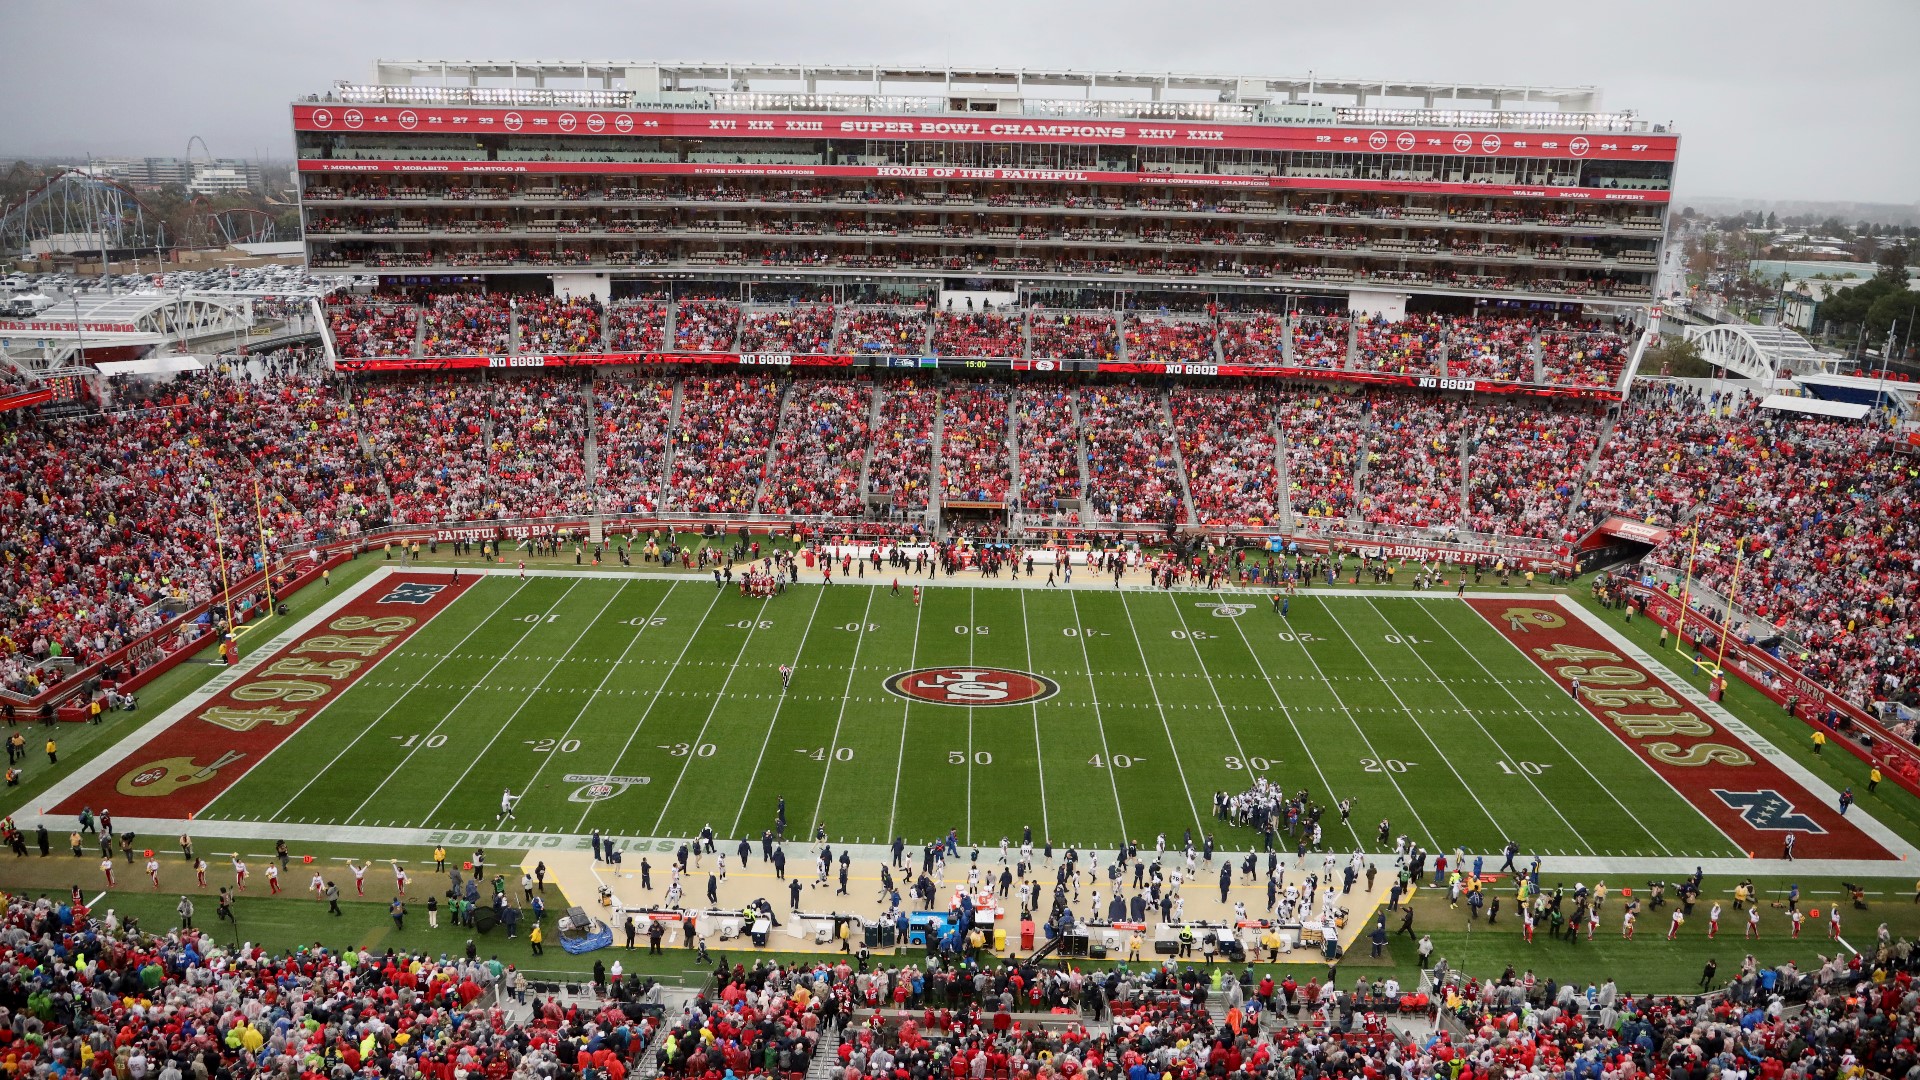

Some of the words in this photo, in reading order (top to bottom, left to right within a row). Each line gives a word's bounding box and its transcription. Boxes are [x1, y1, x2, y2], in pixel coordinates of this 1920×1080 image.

[709, 120, 736, 130] XVI
[748, 120, 774, 130] XIX
[786, 121, 823, 130] XXIII
[840, 121, 914, 133] SUPER
[920, 122, 986, 134] BOWL
[990, 124, 1126, 138] CHAMPIONS
[1138, 128, 1176, 139] XXIV
[1187, 130, 1224, 140] XXIX
[877, 168, 928, 176] HOME
[933, 168, 955, 176] OF
[960, 170, 994, 178] THE
[1002, 170, 1088, 180] FAITHFUL
[489, 358, 506, 367] NO
[510, 356, 544, 366] GOOD
[739, 355, 755, 364] NO
[759, 355, 791, 364] GOOD
[1166, 364, 1182, 374] NO
[1186, 366, 1218, 375] GOOD
[1418, 378, 1436, 388] NO
[1440, 379, 1475, 390] GOOD
[438, 528, 497, 540] FAITHFUL
[506, 526, 529, 538] THE
[532, 525, 555, 536] BAY
[1395, 546, 1428, 558] HOME
[1438, 550, 1461, 561] THE
[198, 616, 417, 732] 49ERS
[198, 674, 237, 694] END
[1795, 678, 1825, 704] 49ERS
[1532, 644, 1756, 766] 49ERS
[1632, 654, 1654, 664] IT
[1650, 662, 1698, 695] TAKES
[1692, 700, 1724, 718] ALL
[1724, 722, 1754, 738] OF
[1749, 740, 1780, 756] US
[400, 734, 448, 748] 10
[532, 738, 582, 753] 20
[670, 742, 718, 757] 30
[809, 747, 854, 762] 40
[948, 751, 992, 765] 50
[1087, 754, 1132, 768] 40
[1224, 756, 1270, 770] 30
[1359, 758, 1408, 773] 20
[1496, 760, 1542, 774] 10
[426, 831, 562, 848] CHANGE
